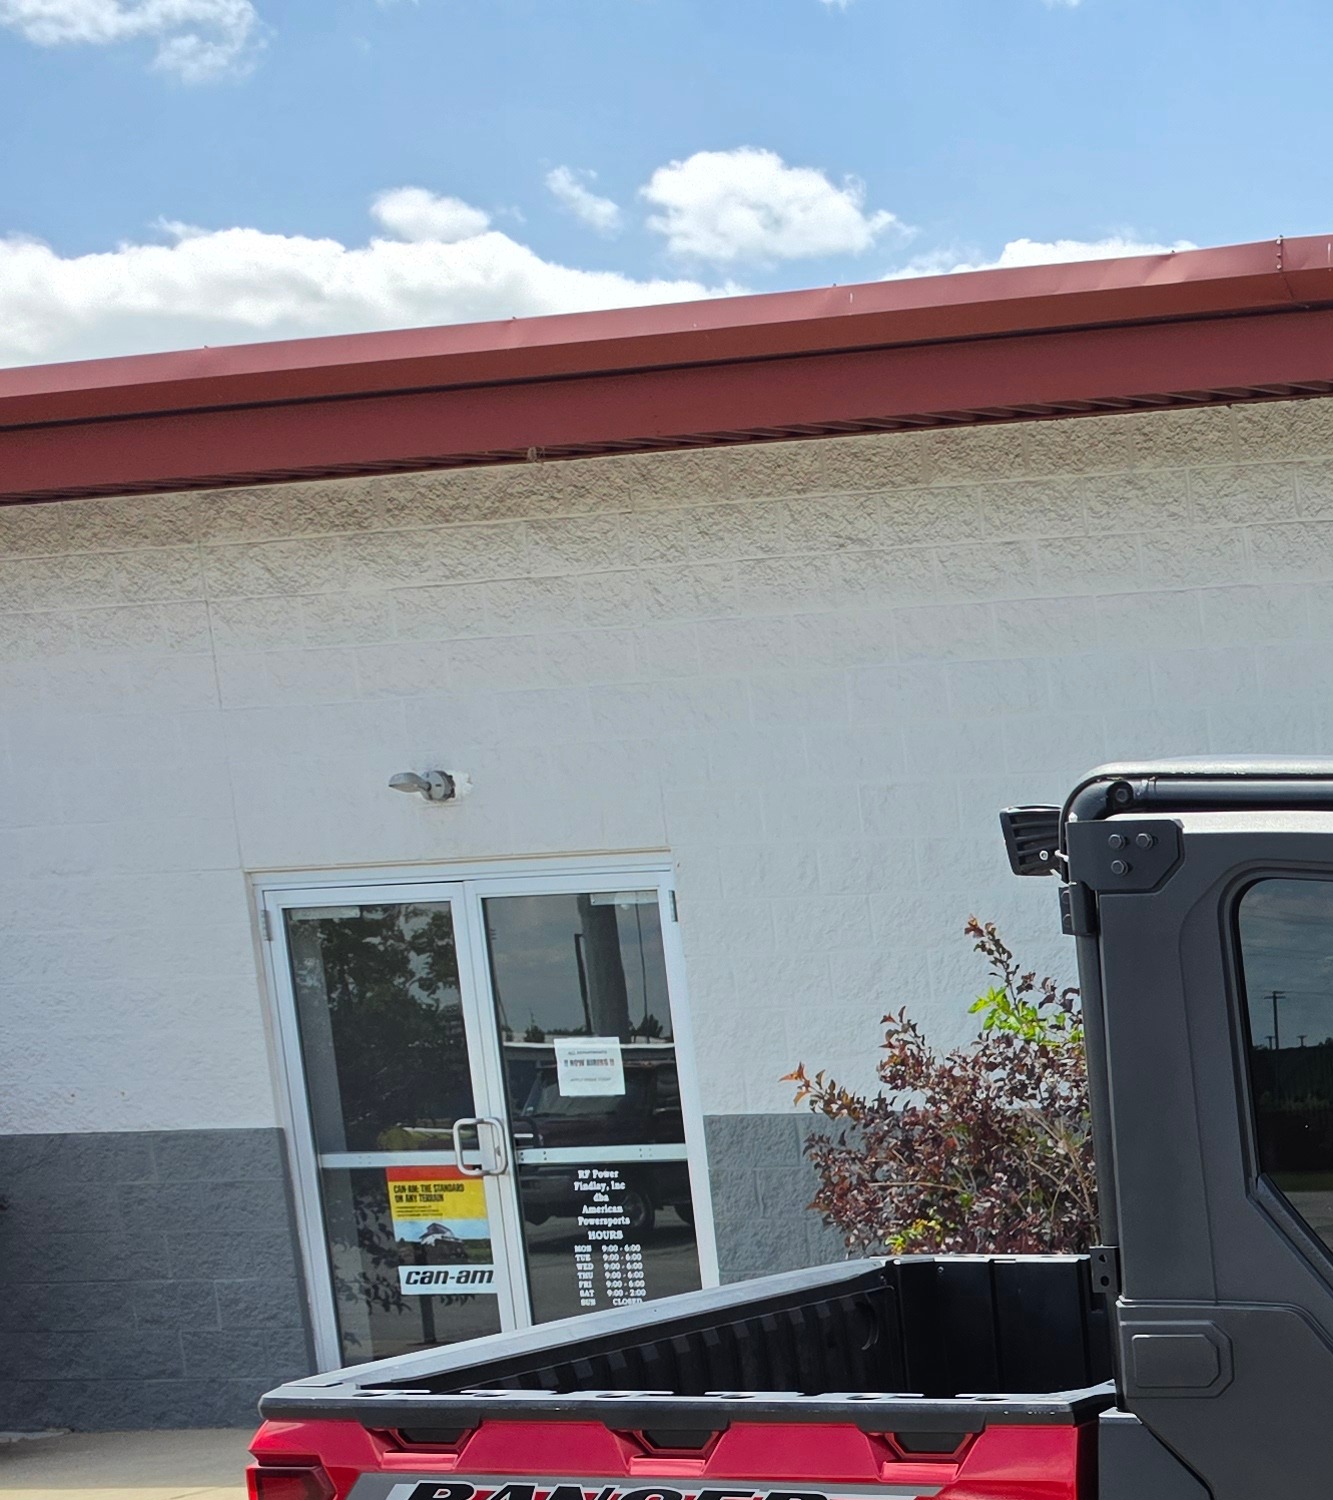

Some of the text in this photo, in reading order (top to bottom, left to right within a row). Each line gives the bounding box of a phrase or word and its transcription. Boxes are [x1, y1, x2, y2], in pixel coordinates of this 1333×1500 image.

[592, 1169, 619, 1179] Power
[574, 1181, 610, 1192] Findlay,
[582, 1204, 624, 1214] American
[578, 1216, 630, 1228] Powersports
[588, 1230, 624, 1240] HOURS
[602, 1244, 618, 1252] 9:00
[624, 1244, 641, 1252] 6:00
[575, 1254, 592, 1262] TUE
[602, 1254, 620, 1262] 9:00
[626, 1253, 642, 1262] 6:00
[604, 1262, 620, 1270] 9:00
[626, 1262, 643, 1270] 6:00
[405, 1270, 494, 1285] can-am
[577, 1272, 594, 1280] THU
[604, 1271, 622, 1280] 9:00
[628, 1271, 644, 1279] 6:00
[606, 1280, 622, 1288] 9:00
[628, 1280, 646, 1288] 6:00
[580, 1290, 595, 1298] SAT
[606, 1289, 624, 1297] 9:00
[630, 1288, 646, 1297] 2:00
